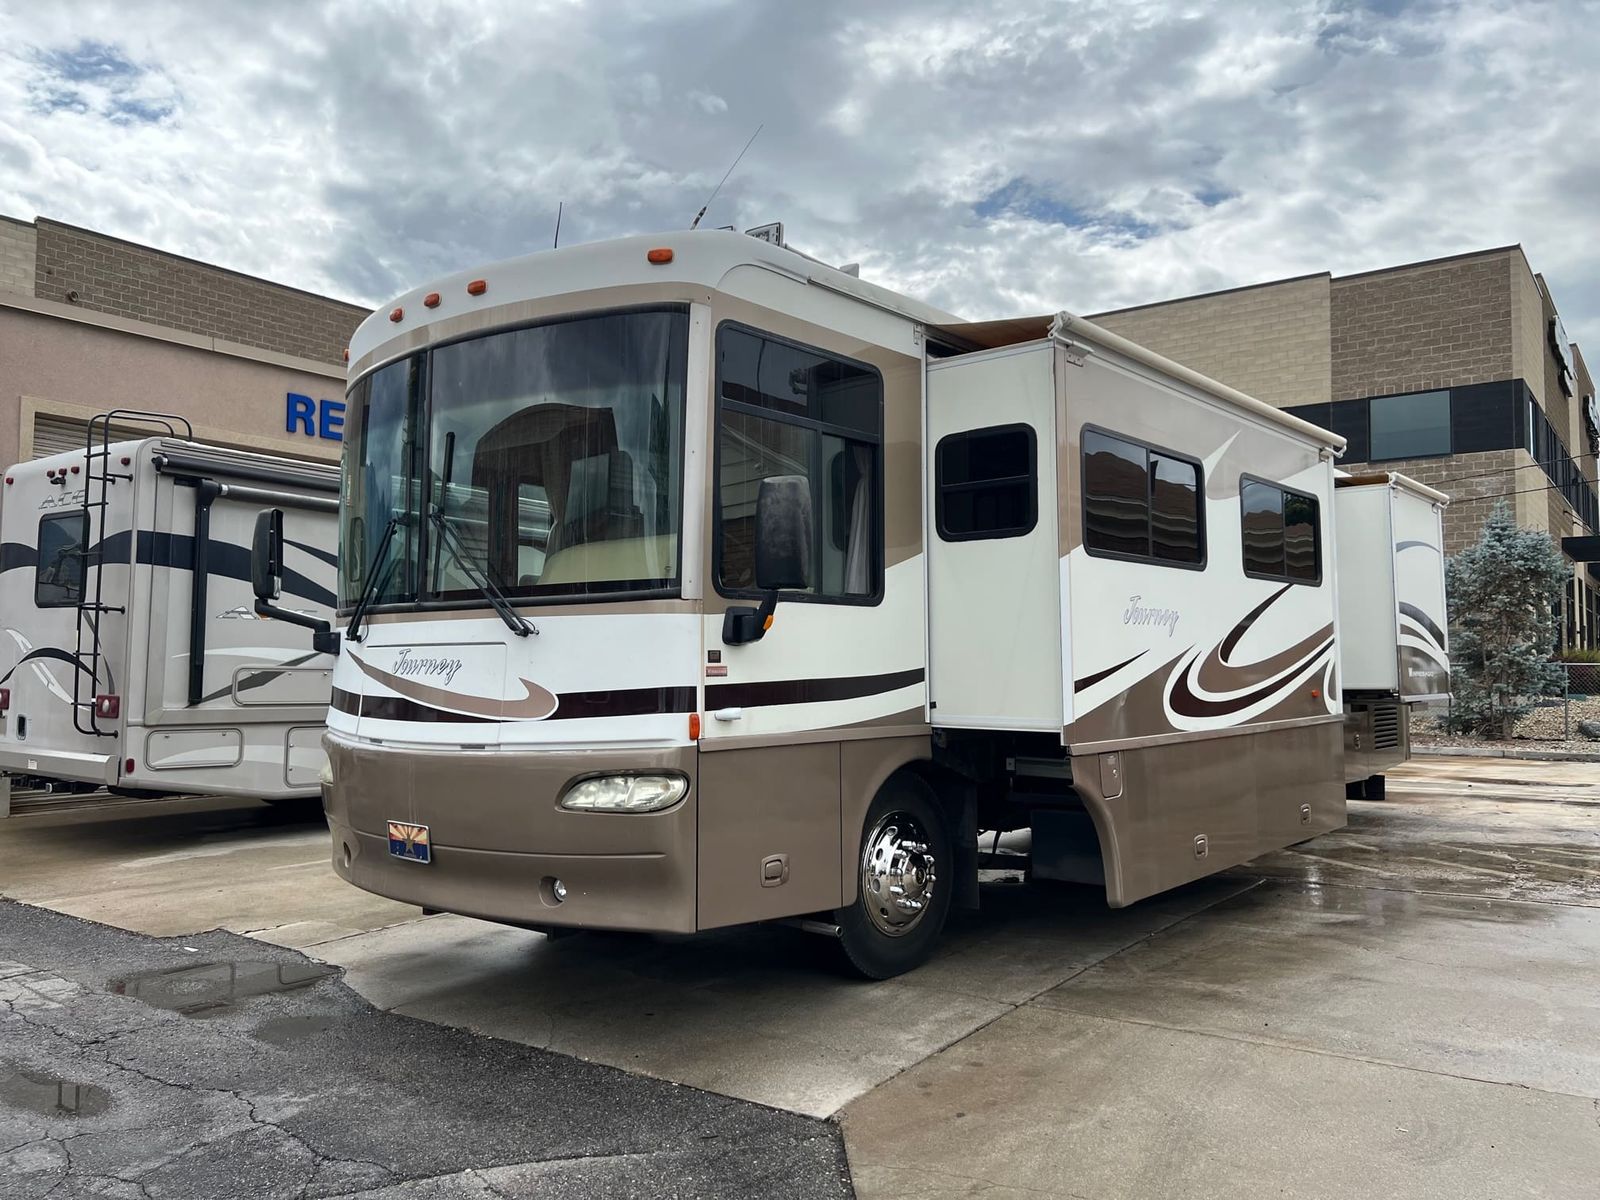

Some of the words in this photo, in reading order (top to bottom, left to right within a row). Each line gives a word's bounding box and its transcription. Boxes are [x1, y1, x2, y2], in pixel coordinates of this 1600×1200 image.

[286, 392, 346, 442] RE
[1123, 594, 1180, 638] Journey
[392, 647, 463, 686] Journey
